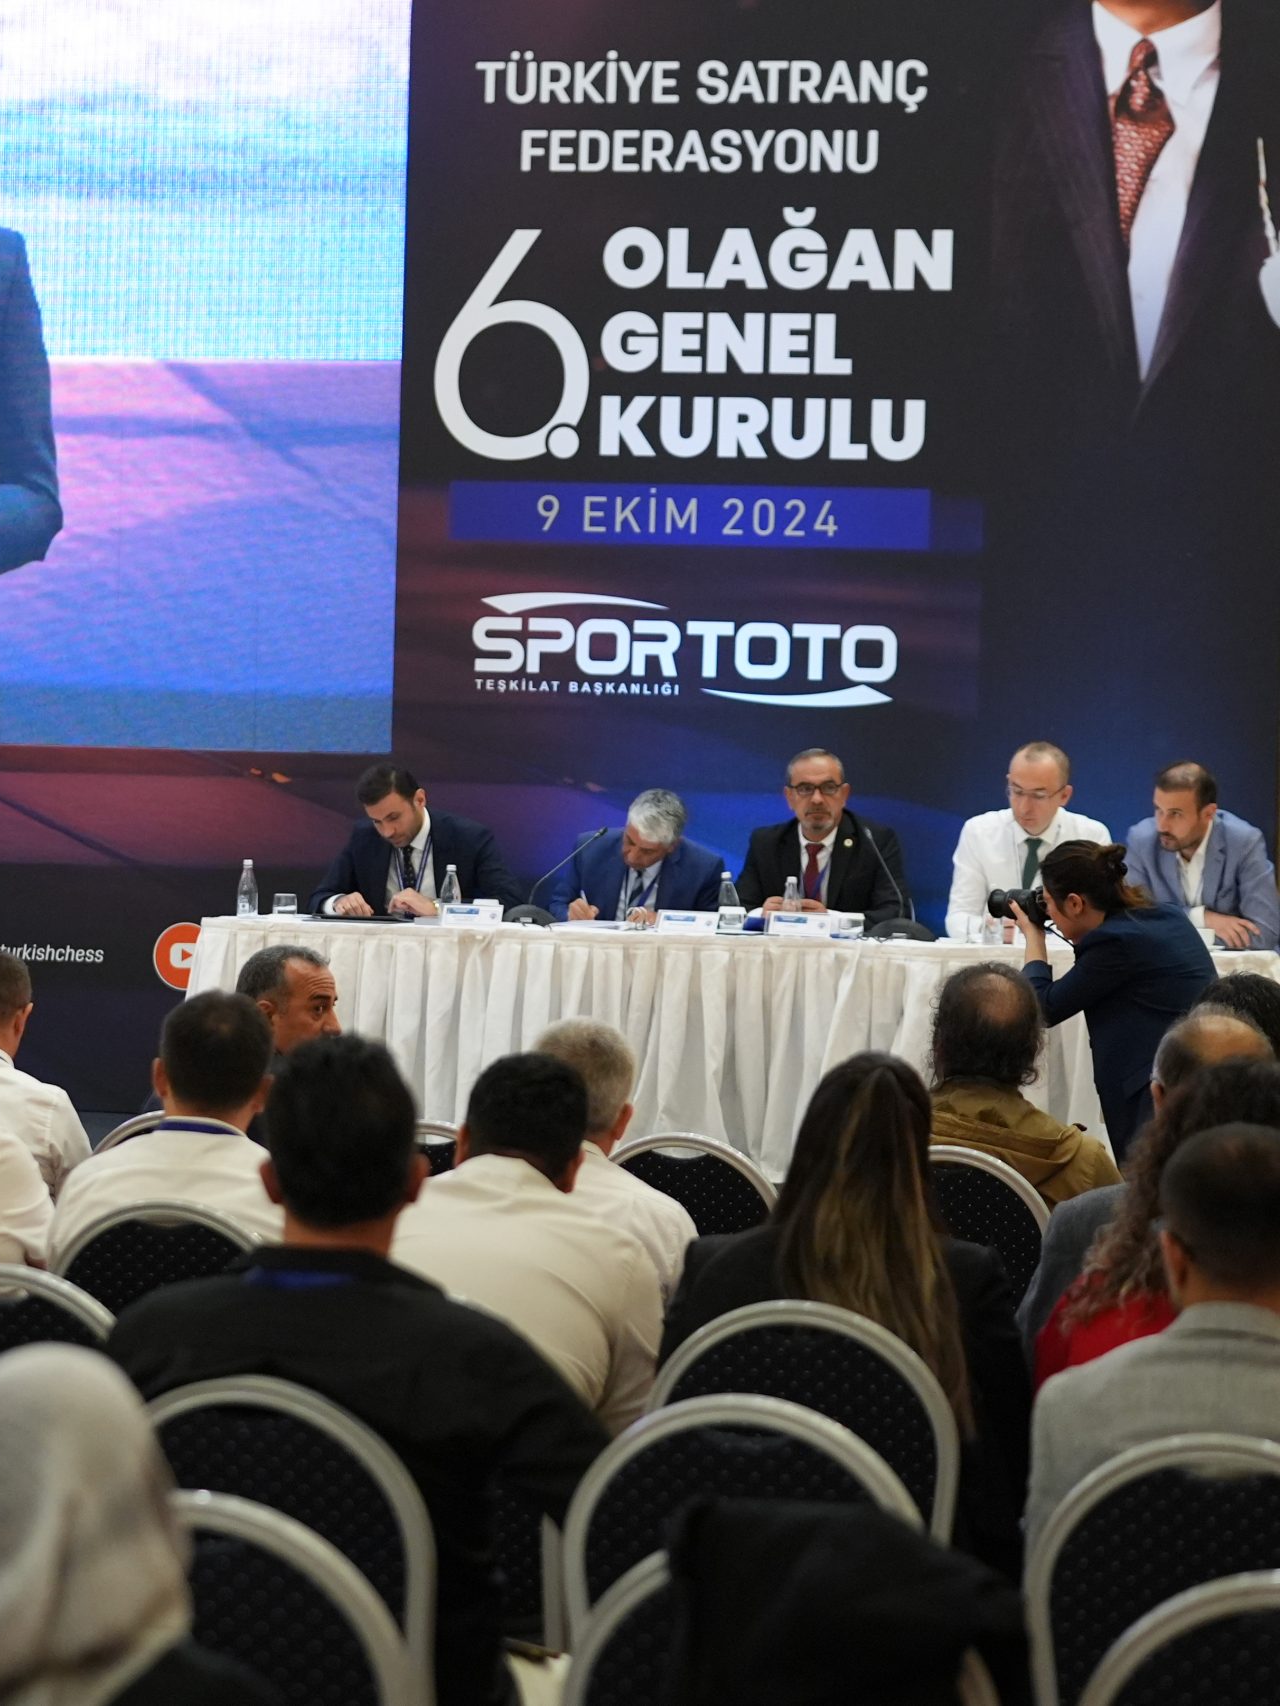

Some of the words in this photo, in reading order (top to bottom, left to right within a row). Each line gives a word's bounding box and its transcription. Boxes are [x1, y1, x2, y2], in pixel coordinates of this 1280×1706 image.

[475, 50, 680, 104] TÜRKİYE
[696, 58, 928, 113] SATRANÇ
[520, 129, 879, 174] FEDERASYONU
[603, 206, 954, 291] OLAĞAN
[434, 228, 590, 461] 6.
[600, 310, 852, 375] GENEL
[599, 394, 926, 462] KURULU
[537, 494, 560, 532] 9
[582, 487, 698, 535] EKİM
[722, 498, 838, 537] 2024
[475, 678, 560, 693] TEŞKİLAT
[568, 681, 680, 696] BAŞKANLIĞI
